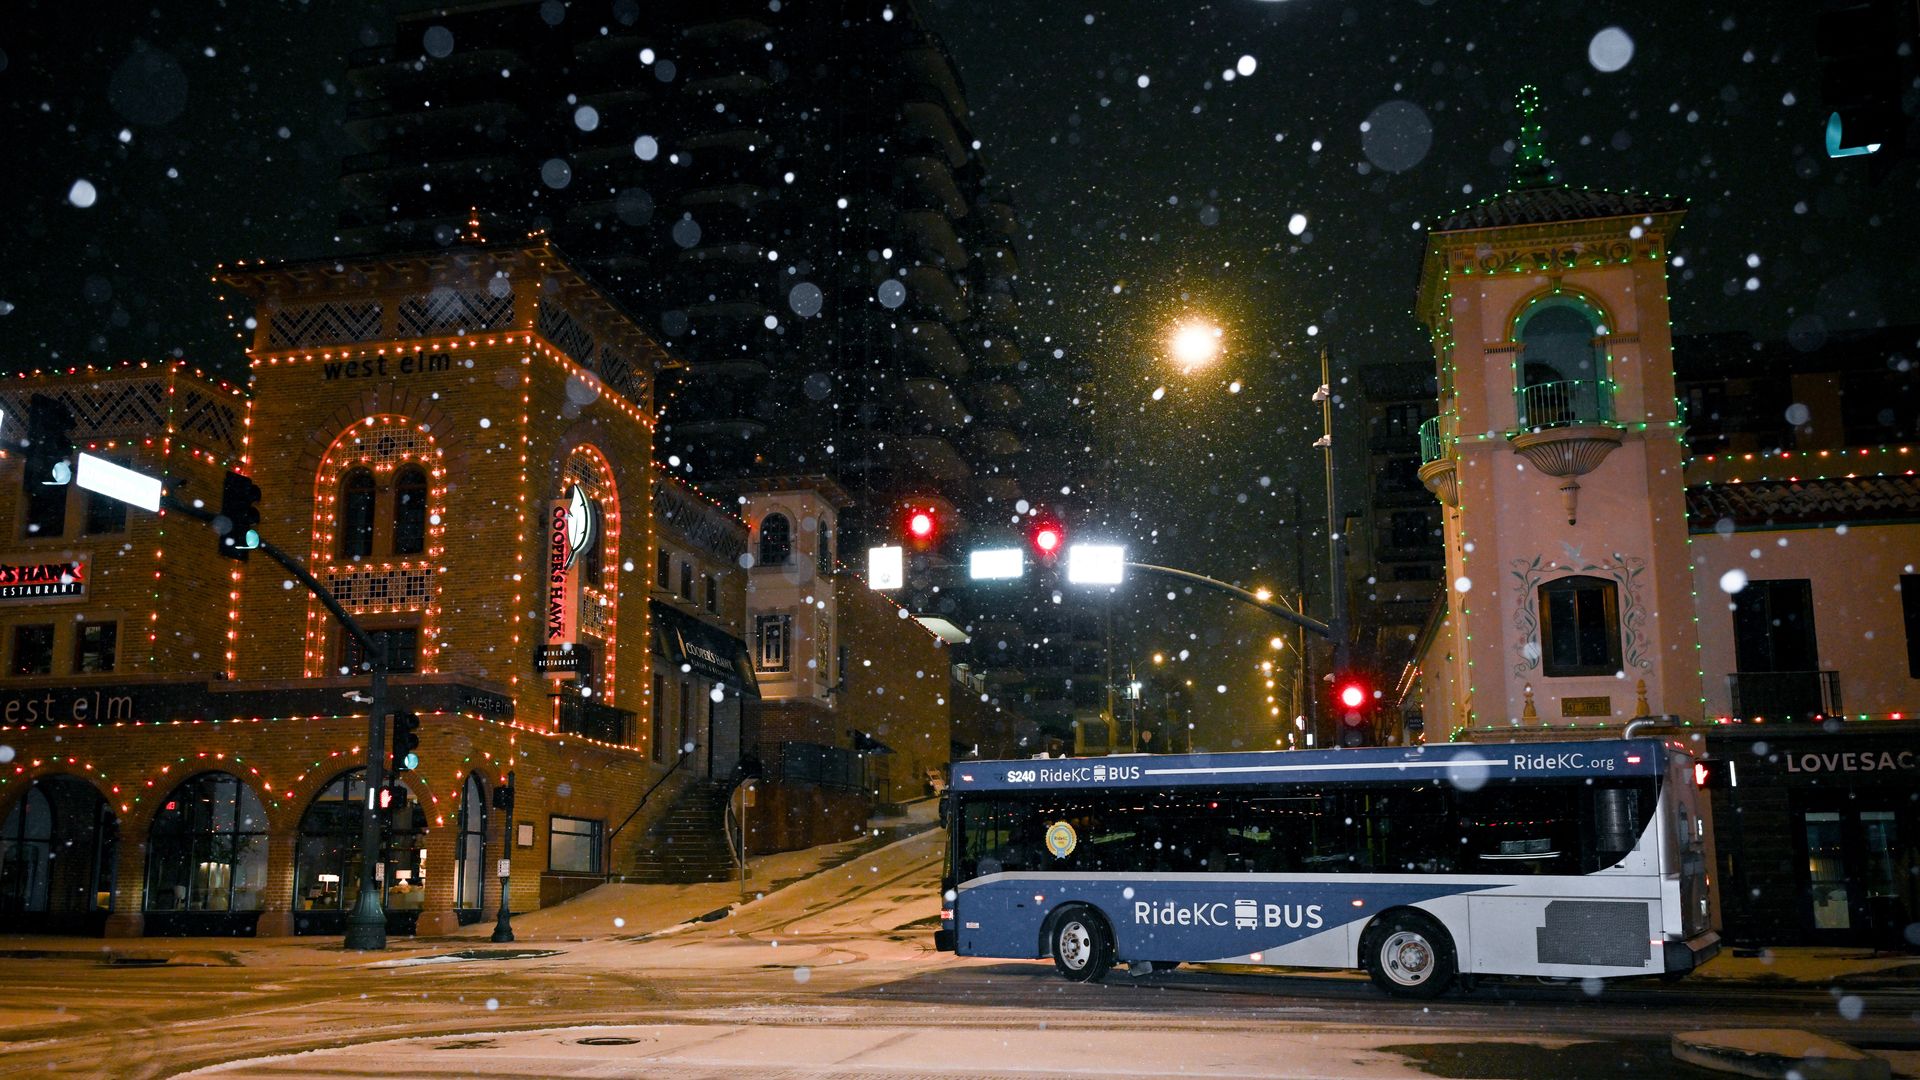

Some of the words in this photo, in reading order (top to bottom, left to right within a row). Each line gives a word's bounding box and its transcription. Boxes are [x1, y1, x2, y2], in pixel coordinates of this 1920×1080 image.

[324, 354, 387, 380] west
[399, 350, 450, 374] elm
[550, 506, 567, 583] COOPER'S
[18, 562, 83, 582] HAWK
[2, 584, 75, 597] ESTAURANT
[549, 586, 565, 639] HAWK
[538, 659, 579, 667] RESTAURANT
[4, 692, 56, 723] est
[72, 690, 133, 721] elm
[470, 696, 492, 710] west
[495, 699, 513, 715] elm
[1514, 753, 1615, 771] RideKC.org
[1786, 751, 1916, 774] LOVESAC
[1007, 770, 1036, 783] S240
[1040, 767, 1091, 783] RideKC
[1109, 766, 1140, 781] BUS
[1134, 900, 1229, 926] RideKC
[1264, 903, 1324, 929] BUS
